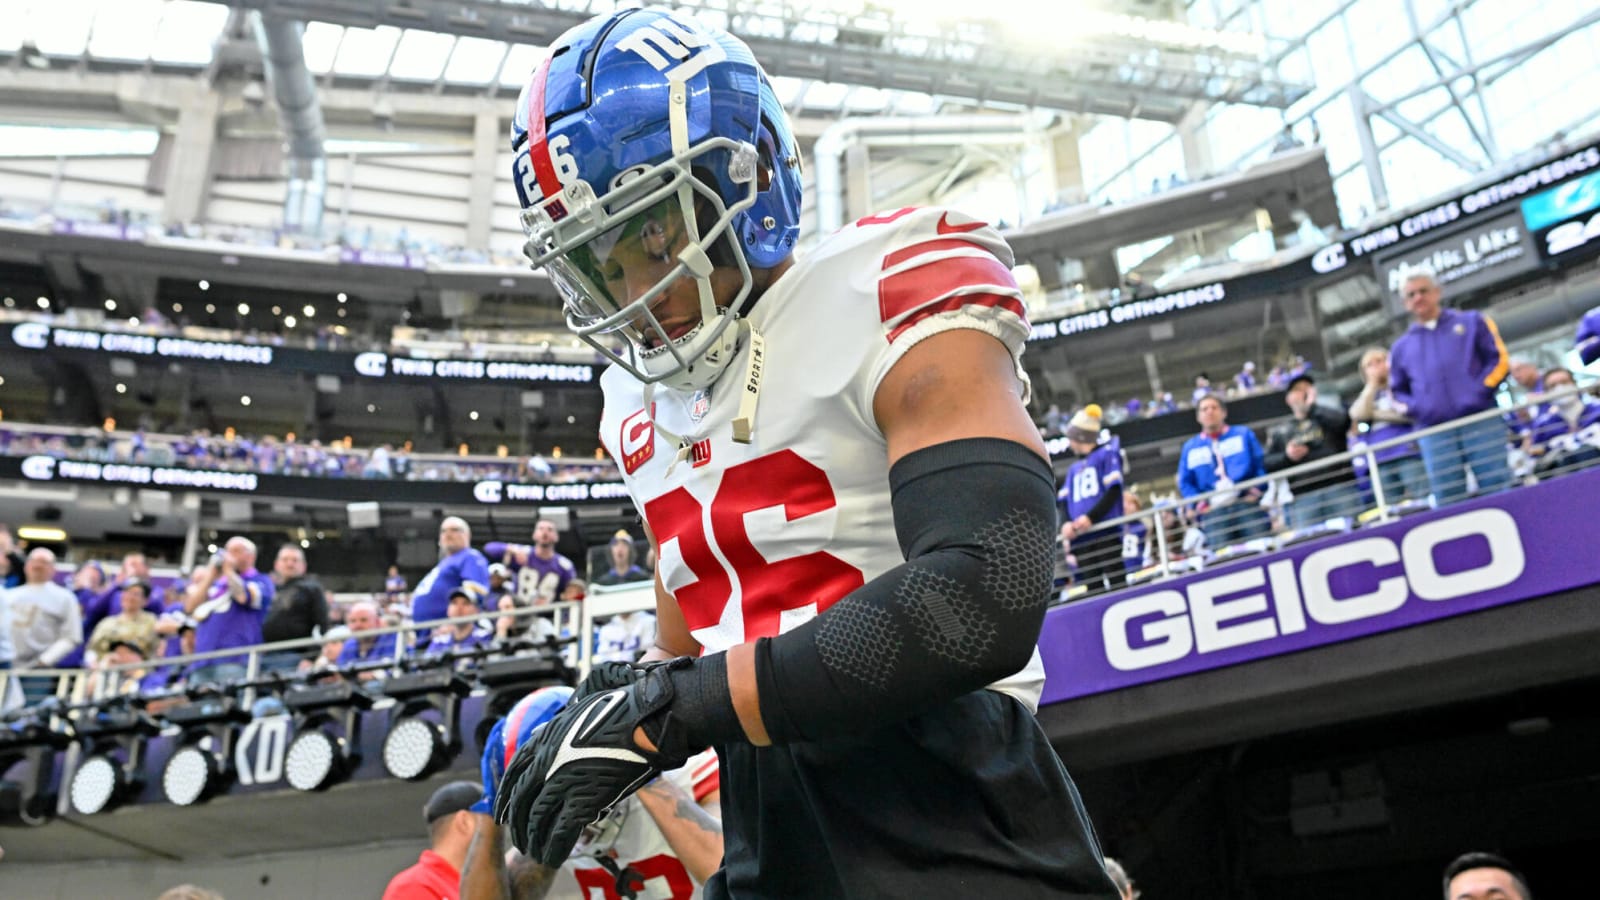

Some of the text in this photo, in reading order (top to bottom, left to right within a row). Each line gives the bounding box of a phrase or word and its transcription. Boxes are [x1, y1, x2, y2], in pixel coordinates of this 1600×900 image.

[1351, 147, 1600, 256] TWIN CITIES ORTHOPEDICS
[1031, 283, 1225, 342] WIN CITIES ORTHOPEDICS
[53, 329, 100, 348] TWIN
[102, 333, 155, 353] CITIES
[157, 338, 272, 364] ORTHOPEDICS
[392, 358, 434, 376] TWIN
[436, 361, 485, 378] CITIES
[487, 363, 592, 381] ORTHOPEDICS
[59, 461, 101, 479] TWIN
[102, 464, 151, 483] CITIES
[152, 467, 258, 490] ORTHOPEDICS
[506, 484, 544, 500] TWIN
[546, 484, 588, 500] CITIES
[1073, 466, 1099, 503] 18
[517, 566, 561, 605] 84
[1102, 508, 1525, 671] GEICO
